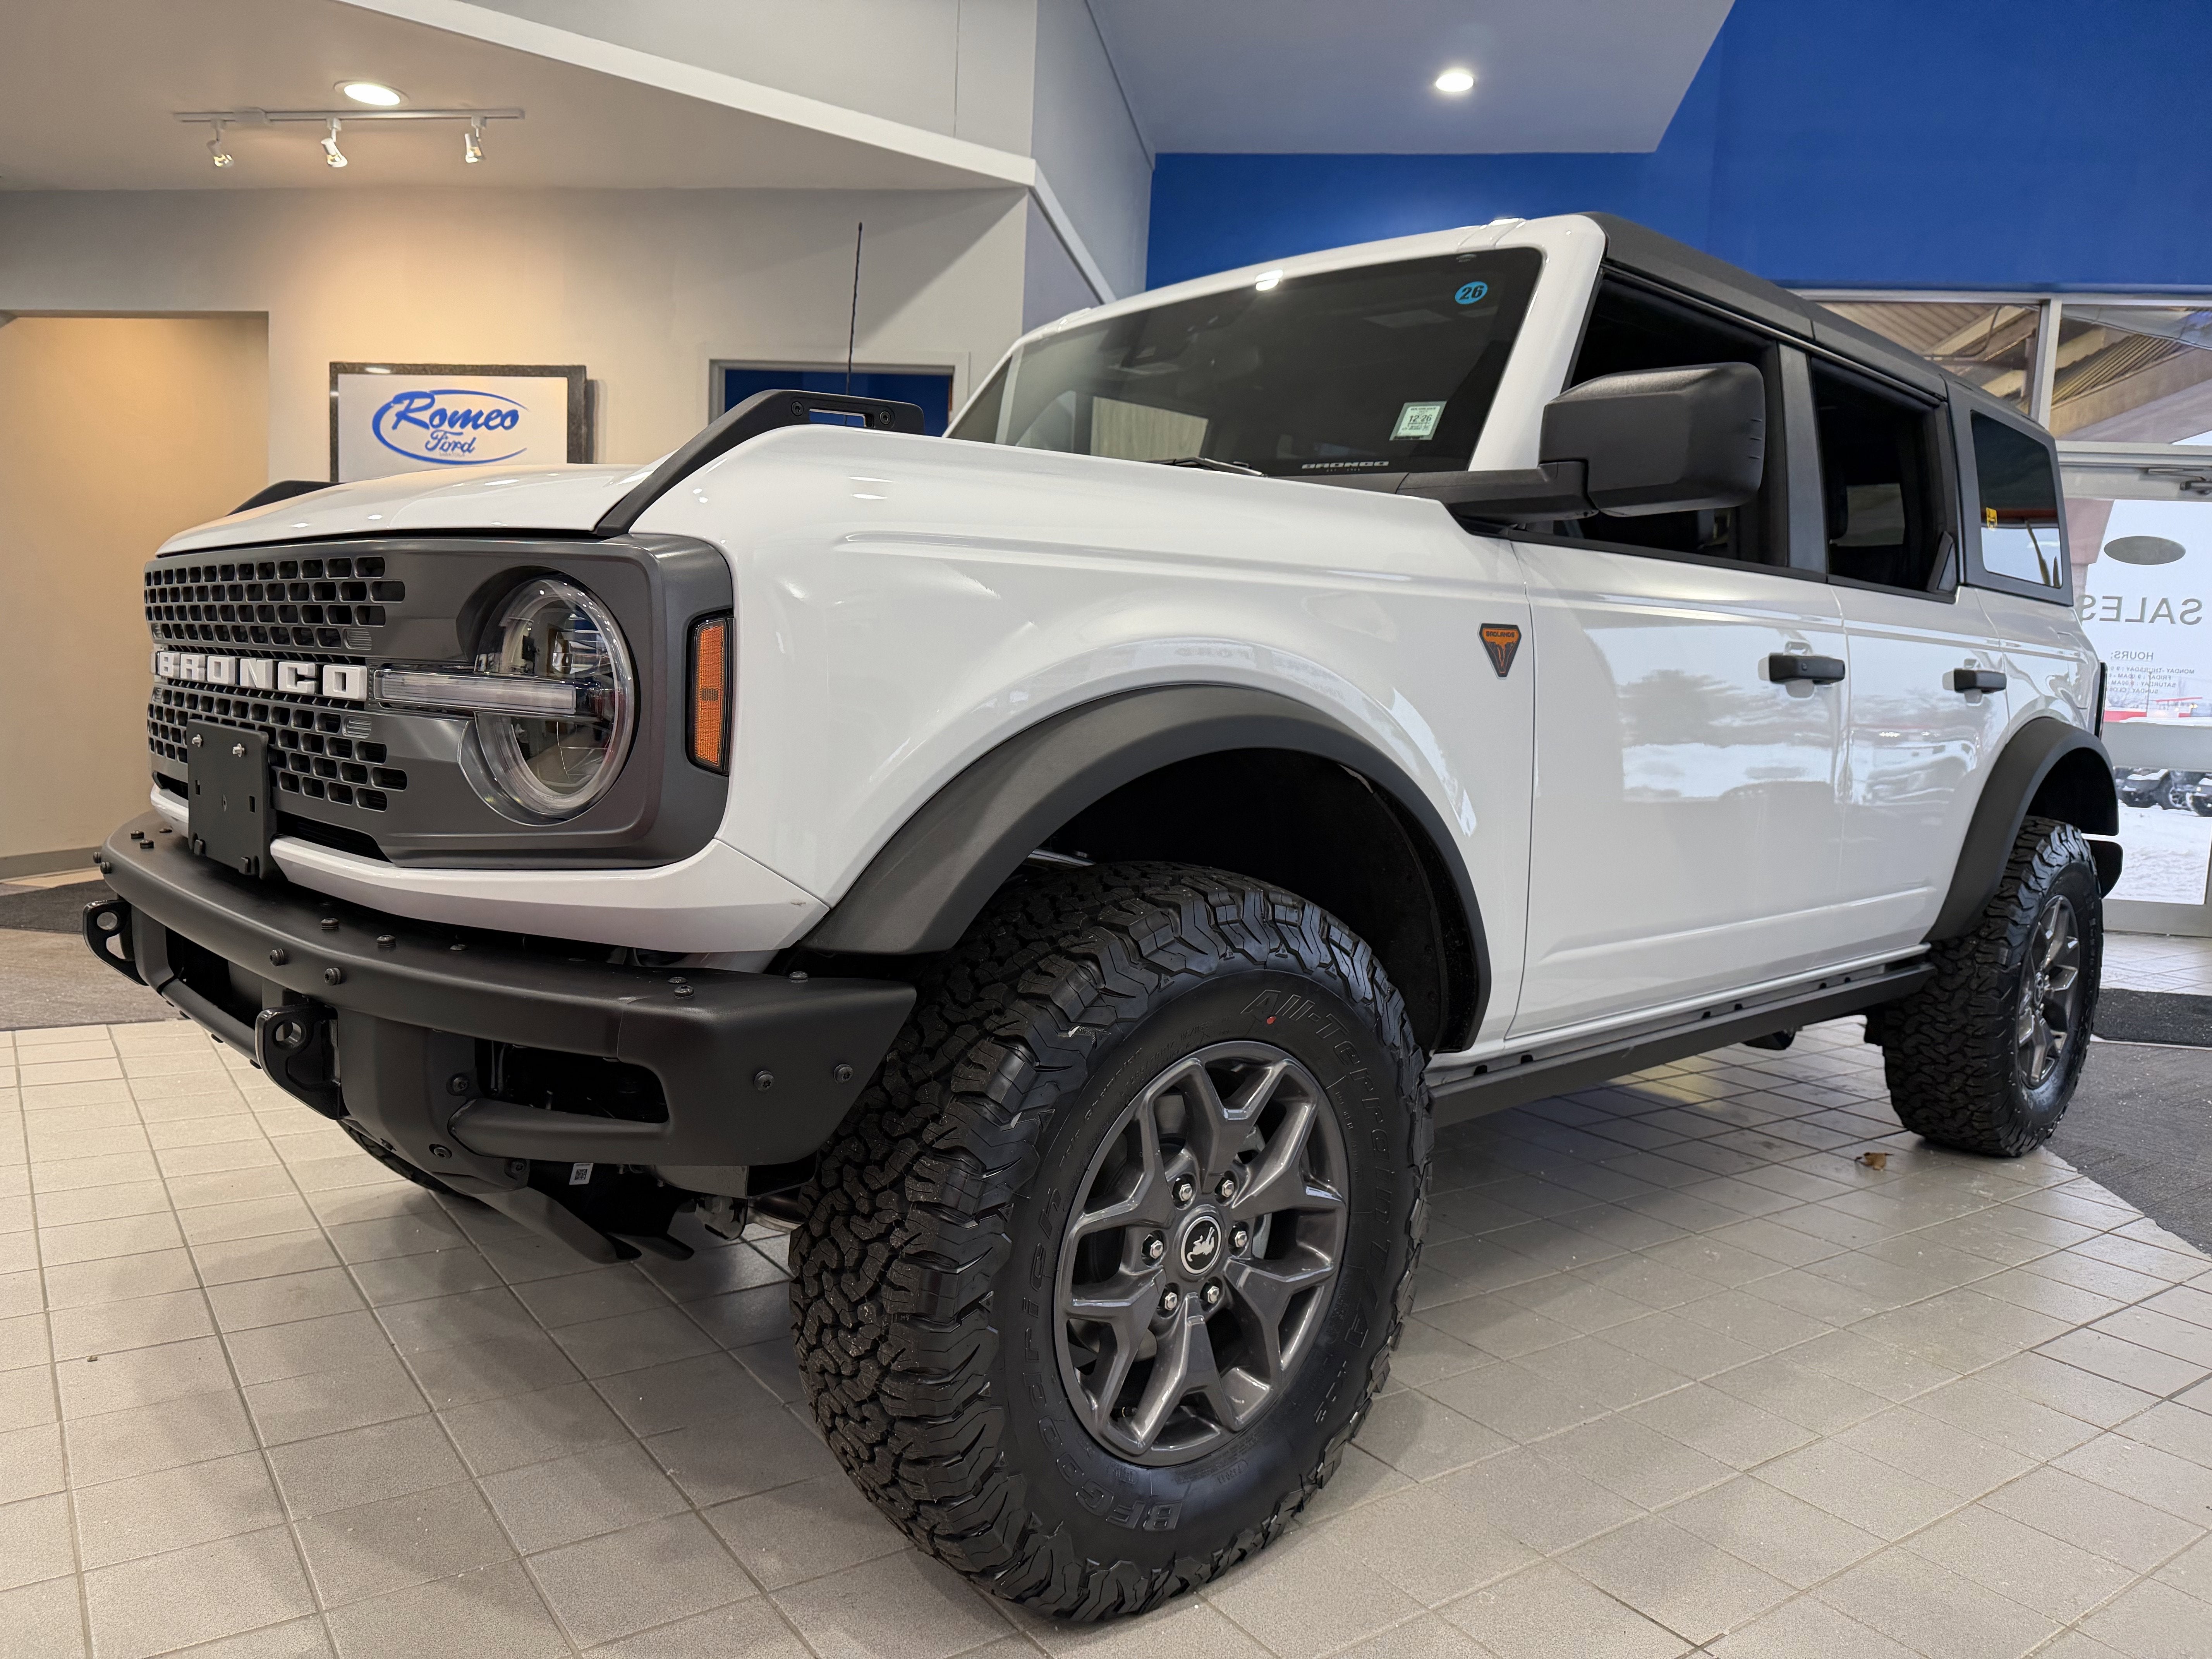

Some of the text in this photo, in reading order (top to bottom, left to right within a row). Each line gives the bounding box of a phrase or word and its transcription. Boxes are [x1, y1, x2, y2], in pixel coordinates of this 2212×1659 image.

[1459, 285, 1484, 301] 26
[392, 390, 519, 431] Romeo
[425, 430, 476, 454] Ford
[157, 651, 368, 702] BRONCO
[1240, 989, 1391, 1224] All-Terrain
[1022, 1187, 1183, 1532] BFGoodrich
